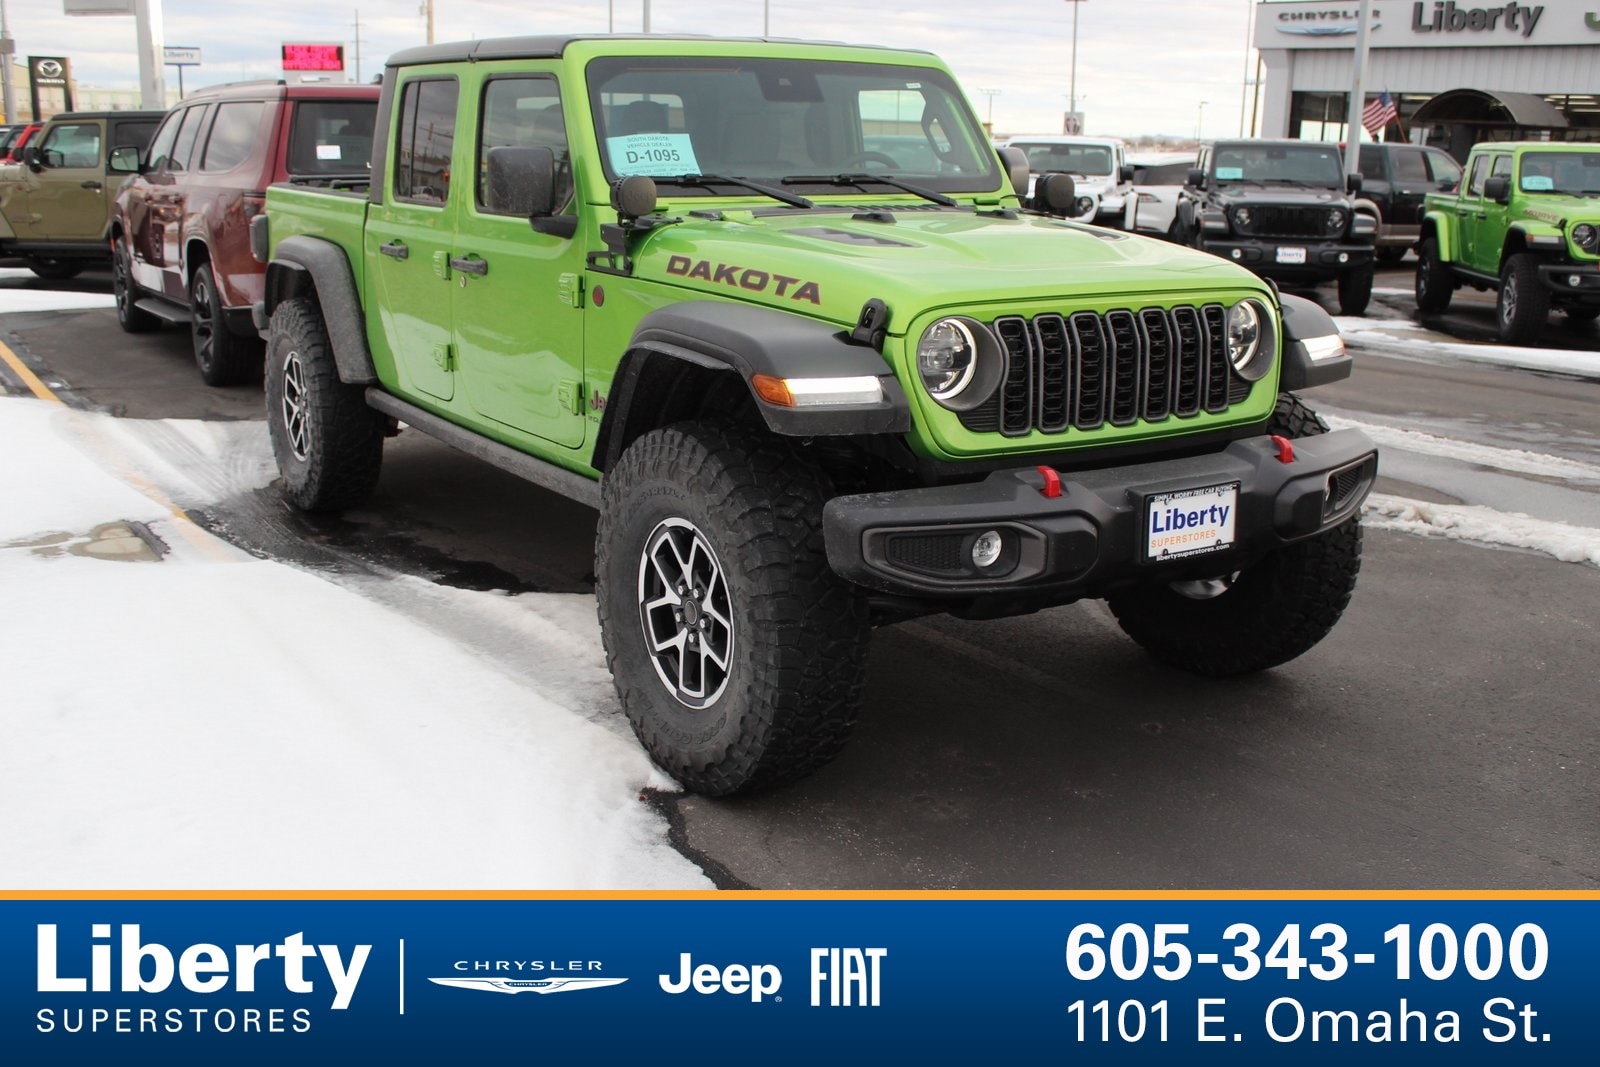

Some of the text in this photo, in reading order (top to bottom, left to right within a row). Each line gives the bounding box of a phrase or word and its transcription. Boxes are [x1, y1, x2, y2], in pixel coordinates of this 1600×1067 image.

[1411, 1, 1544, 38] Liberty
[626, 149, 681, 164] D-1095
[666, 255, 821, 305] DAKOTA
[1152, 504, 1230, 533] Liberty
[1151, 529, 1216, 548] SUPERSTORES
